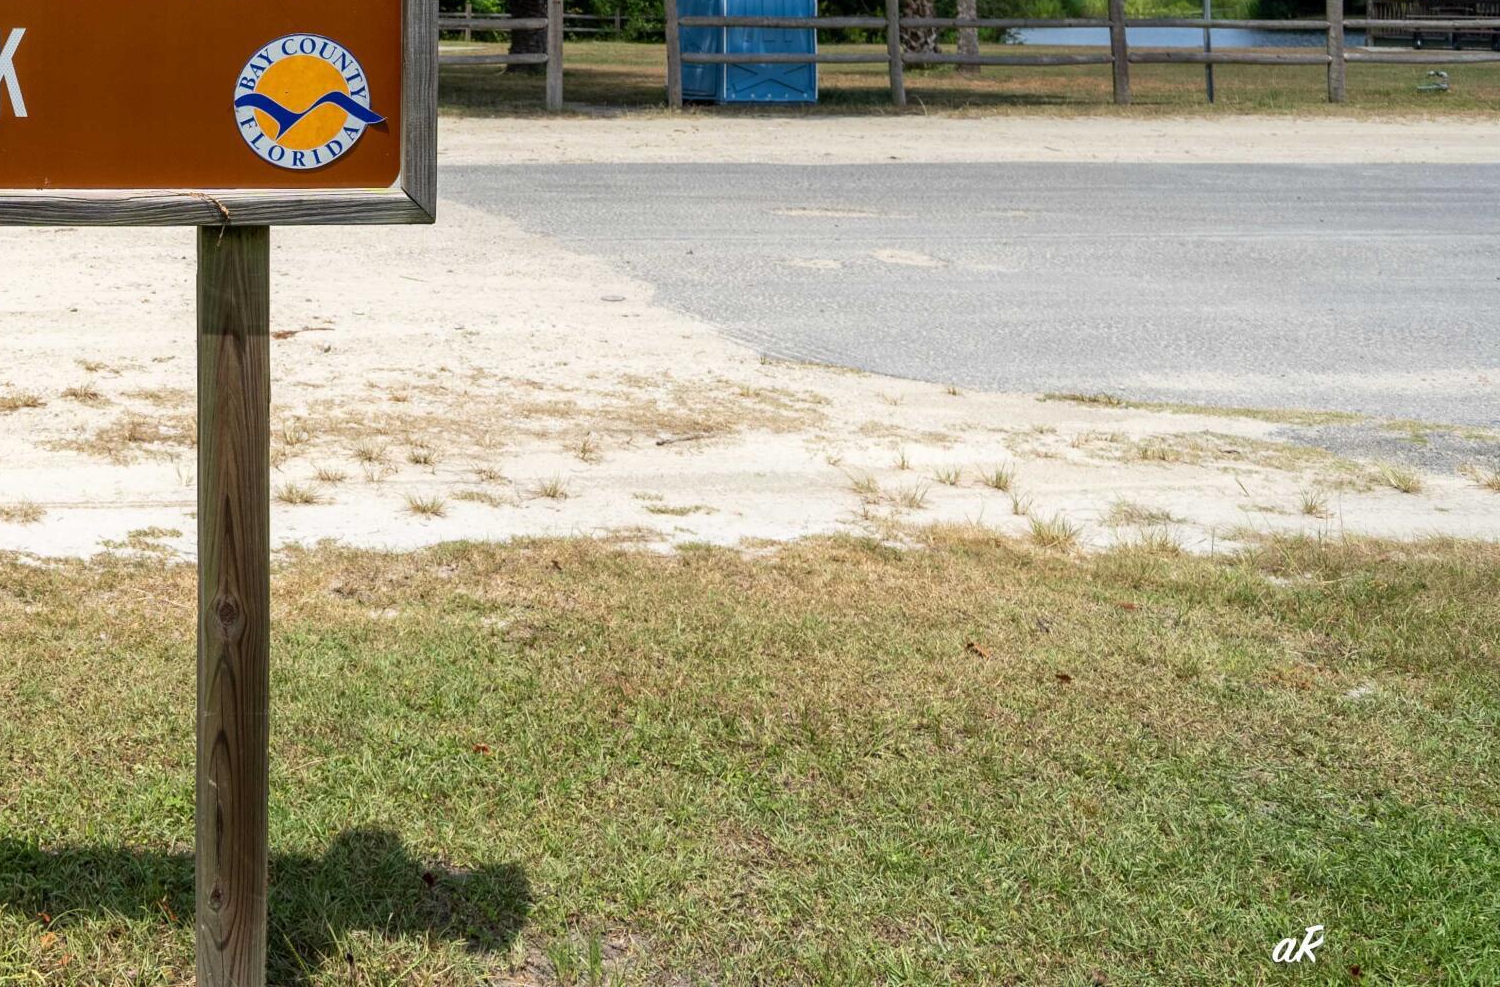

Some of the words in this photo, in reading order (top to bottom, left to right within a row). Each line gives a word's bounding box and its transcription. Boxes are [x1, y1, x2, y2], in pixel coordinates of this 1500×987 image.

[239, 48, 275, 92] BAY
[281, 37, 368, 99] COUNTY
[240, 115, 361, 167] FLORIDA
